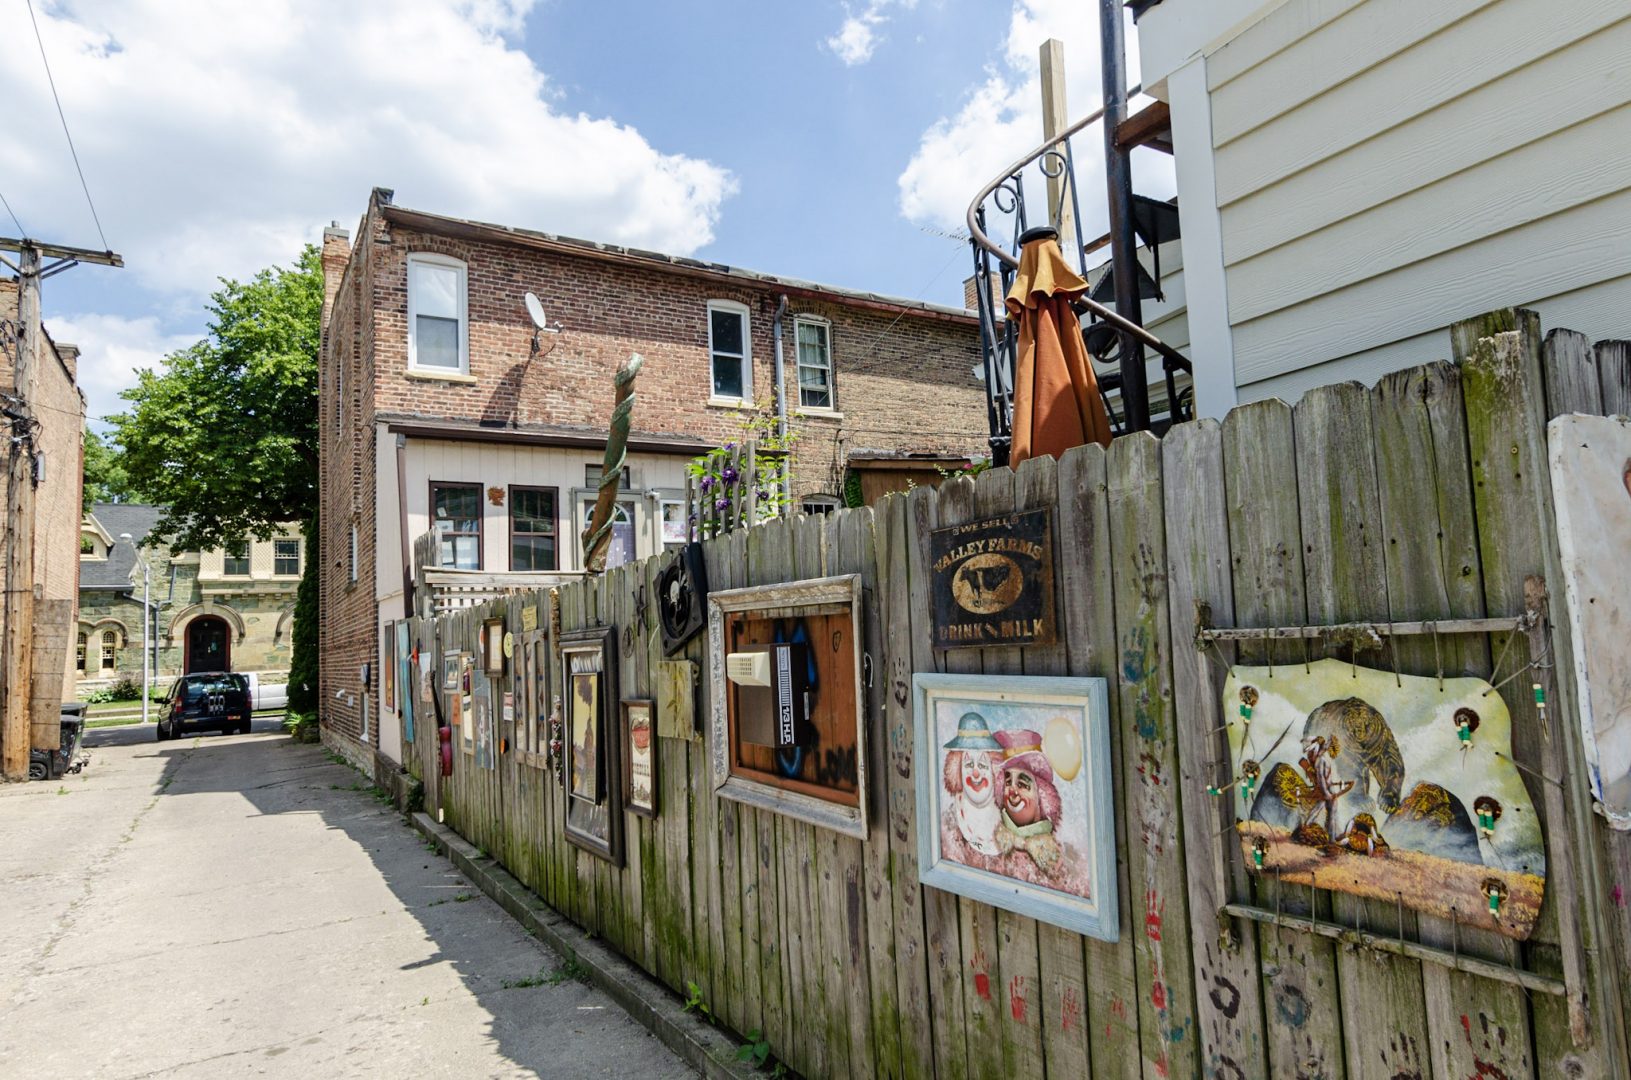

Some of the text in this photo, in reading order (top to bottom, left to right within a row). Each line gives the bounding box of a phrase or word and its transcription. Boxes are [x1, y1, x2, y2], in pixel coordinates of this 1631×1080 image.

[961, 517, 1010, 533] WE SELL
[933, 538, 1043, 573] VALLEY FARMS
[940, 618, 1043, 640] DRINK MILK
